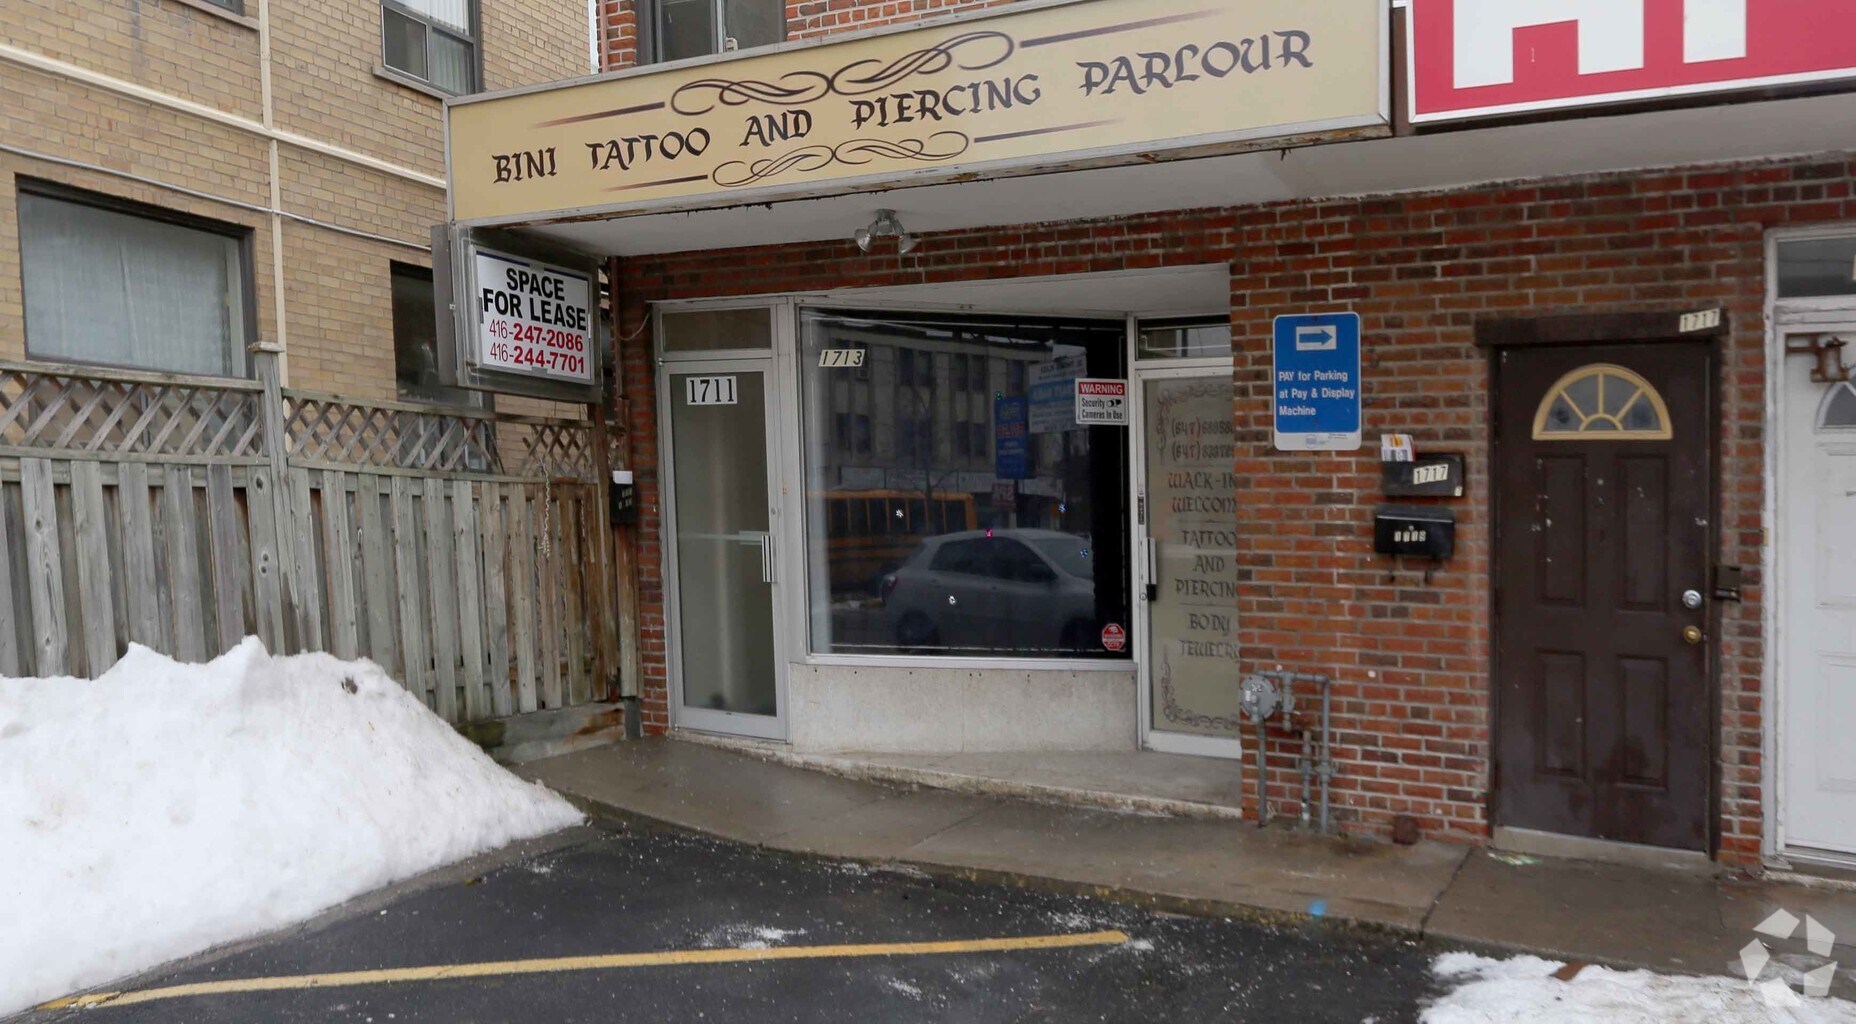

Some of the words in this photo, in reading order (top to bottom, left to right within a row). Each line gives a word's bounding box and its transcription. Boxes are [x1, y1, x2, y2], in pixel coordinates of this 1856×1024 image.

[492, 146, 558, 184] BINI
[585, 127, 711, 172] TATTOO
[739, 108, 812, 147] AND
[849, 73, 1041, 130] PIERCING
[1076, 29, 1314, 97] PARLOUR
[506, 267, 565, 301] SPACE
[482, 288, 523, 319] FOR
[529, 297, 587, 331] LEASE
[489, 318, 584, 352] 416-247-2086
[490, 342, 585, 374] 416-244-7701
[821, 350, 863, 366] 1713
[1278, 371, 1294, 381] PAY
[1298, 370, 1311, 381] for
[1314, 369, 1348, 382] Parking
[689, 377, 734, 403] 1711
[1080, 383, 1123, 394] WARNING
[1279, 389, 1288, 398] at
[1291, 387, 1308, 400] Pay
[1311, 387, 1318, 398] &
[1321, 387, 1355, 400] Display
[1082, 397, 1105, 409] Security
[1279, 405, 1317, 415] Machine
[1082, 409, 1105, 419] Cameras
[1416, 465, 1447, 483] 1717
[1192, 555, 1225, 573] AND
[1174, 578, 1236, 597] PIERCIN
[1188, 613, 1230, 636] BODY
